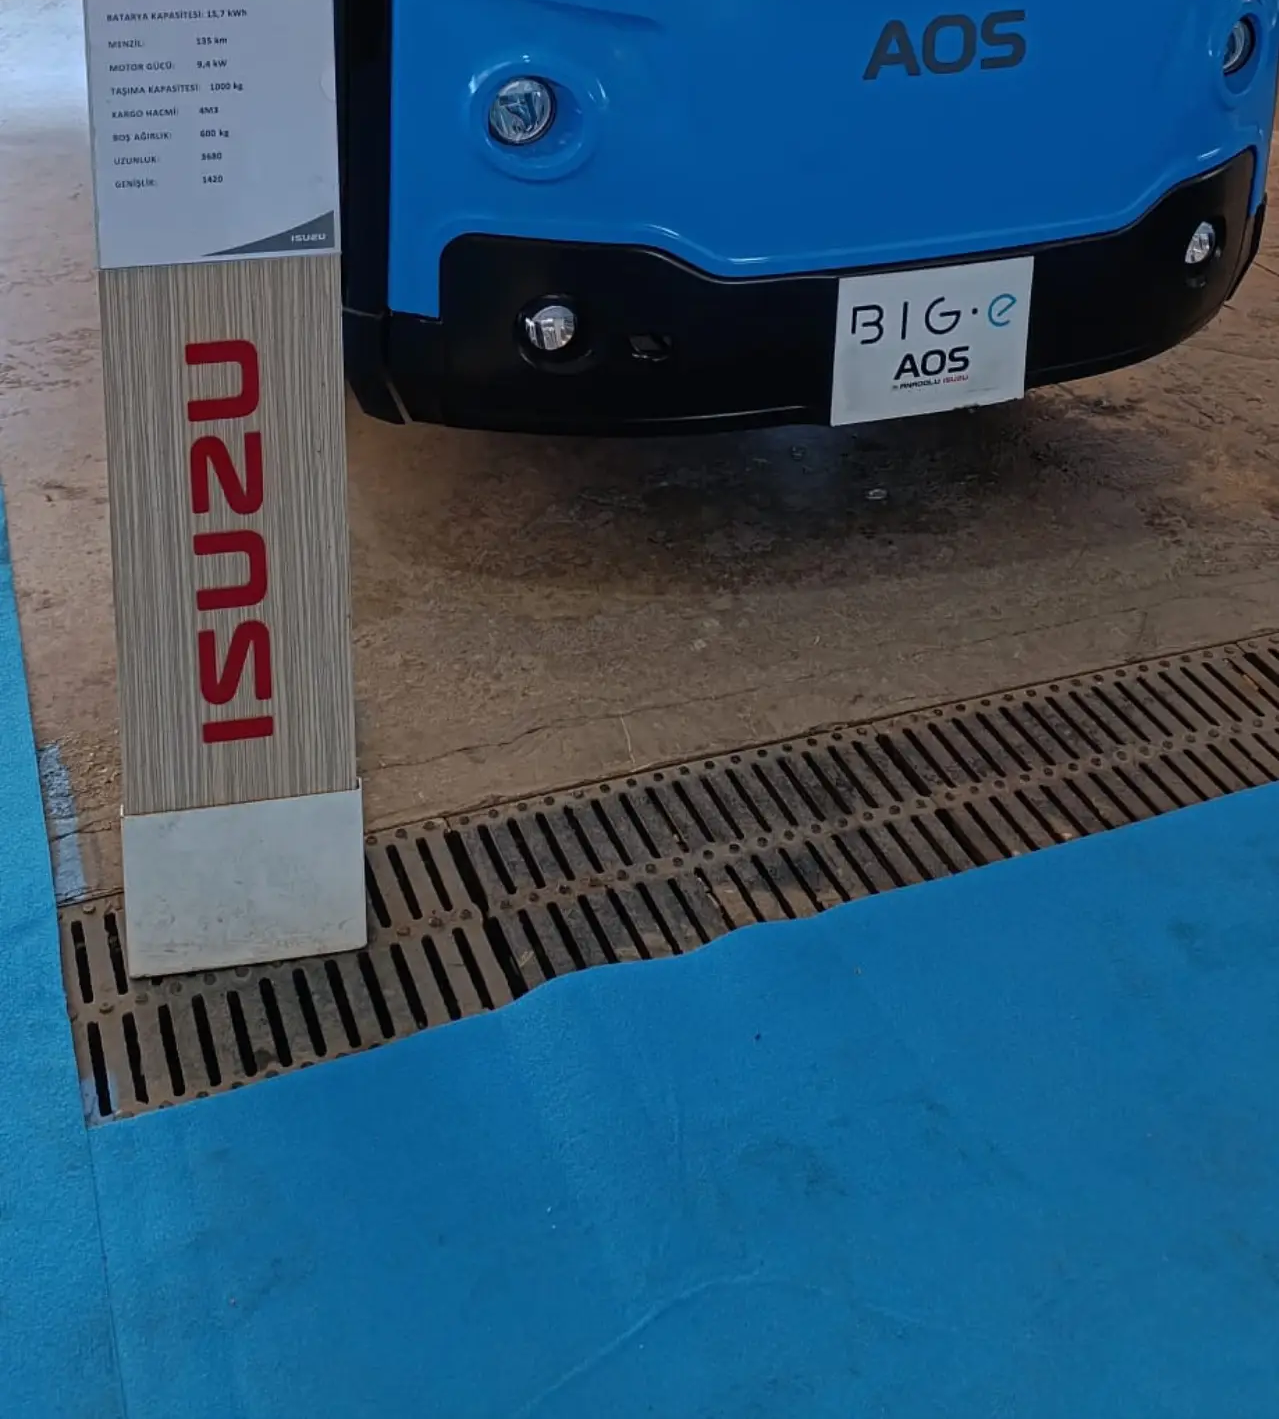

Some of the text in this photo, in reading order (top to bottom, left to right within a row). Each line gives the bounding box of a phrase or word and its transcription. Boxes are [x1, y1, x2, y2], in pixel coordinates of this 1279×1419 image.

[106, 13, 149, 22] BATARYA
[227, 8, 247, 18] kWh
[214, 37, 228, 45] km
[862, 9, 1027, 81] AOS
[109, 63, 144, 72] MOTOR
[212, 59, 228, 68] kW
[111, 86, 146, 97] TAŞIMA
[233, 81, 243, 92] kg
[111, 109, 144, 119] KARGO
[219, 128, 229, 138] kg
[291, 234, 327, 243] ISUZU
[893, 345, 970, 381] AOS
[942, 375, 969, 384] ISUZU
[184, 338, 274, 743] ISUZU
